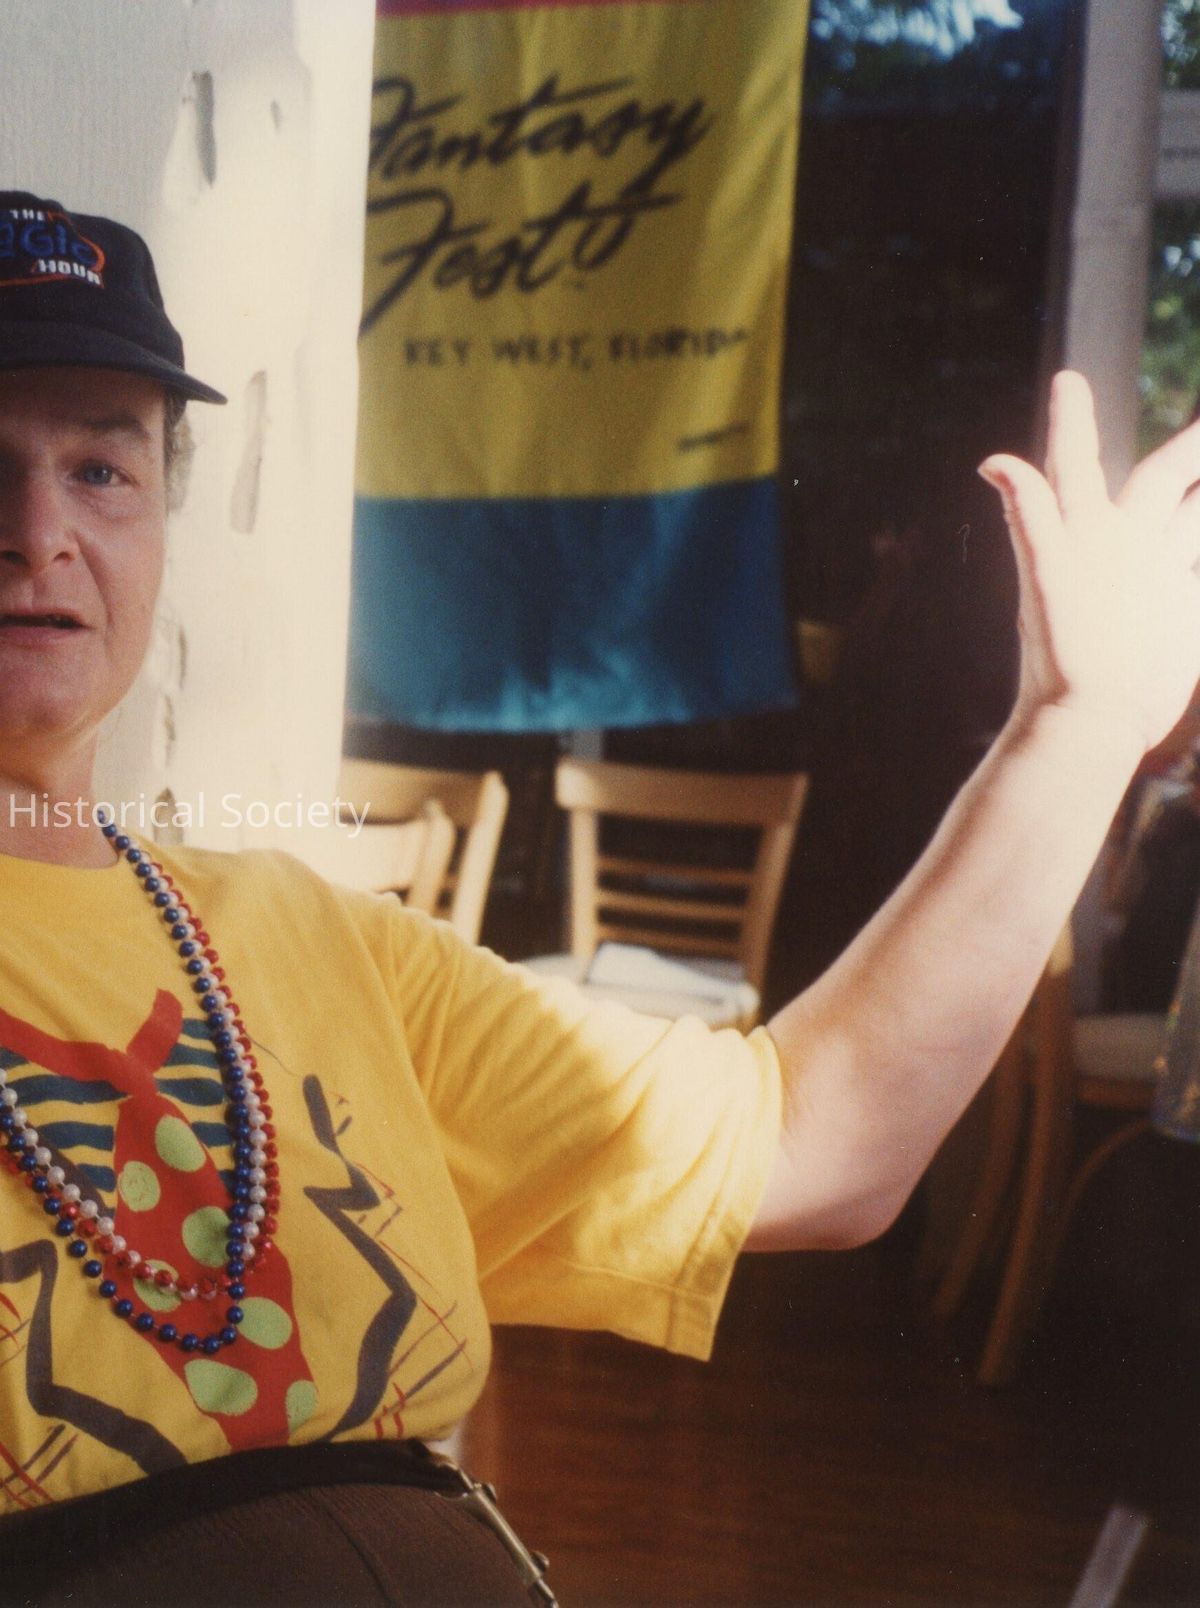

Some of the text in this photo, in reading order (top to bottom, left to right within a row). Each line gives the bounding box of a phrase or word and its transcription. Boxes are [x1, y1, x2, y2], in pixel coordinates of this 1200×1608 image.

[368, 72, 714, 272] Fantasy
[10, 208, 45, 221] THE
[36, 259, 101, 286] HOUR
[404, 335, 469, 367] KEY
